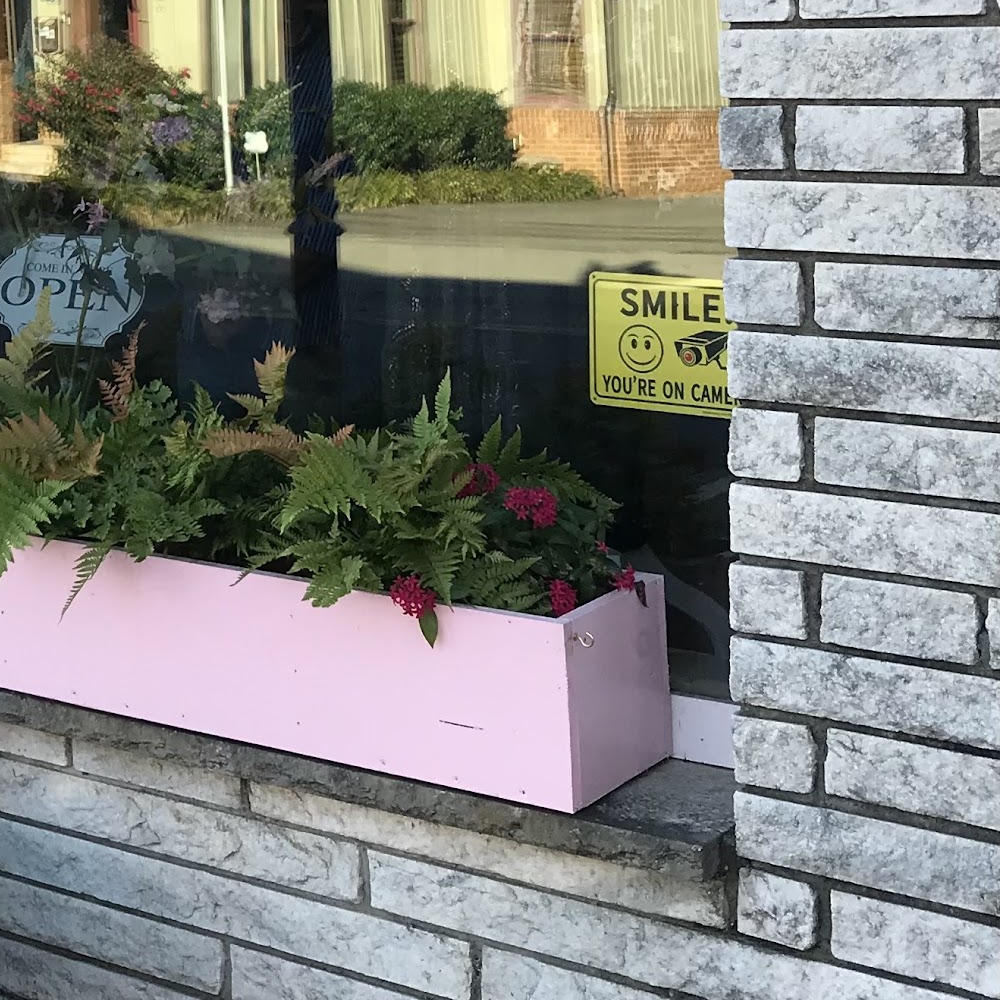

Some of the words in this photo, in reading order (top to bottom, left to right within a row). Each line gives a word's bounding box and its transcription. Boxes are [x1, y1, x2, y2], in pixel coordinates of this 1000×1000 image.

[26, 262, 59, 273] COME
[61, 265, 74, 275] IN
[1, 275, 132, 314] OPEN
[620, 288, 732, 325] SMILE
[602, 375, 656, 397] YOU'RE
[662, 381, 684, 400] ON
